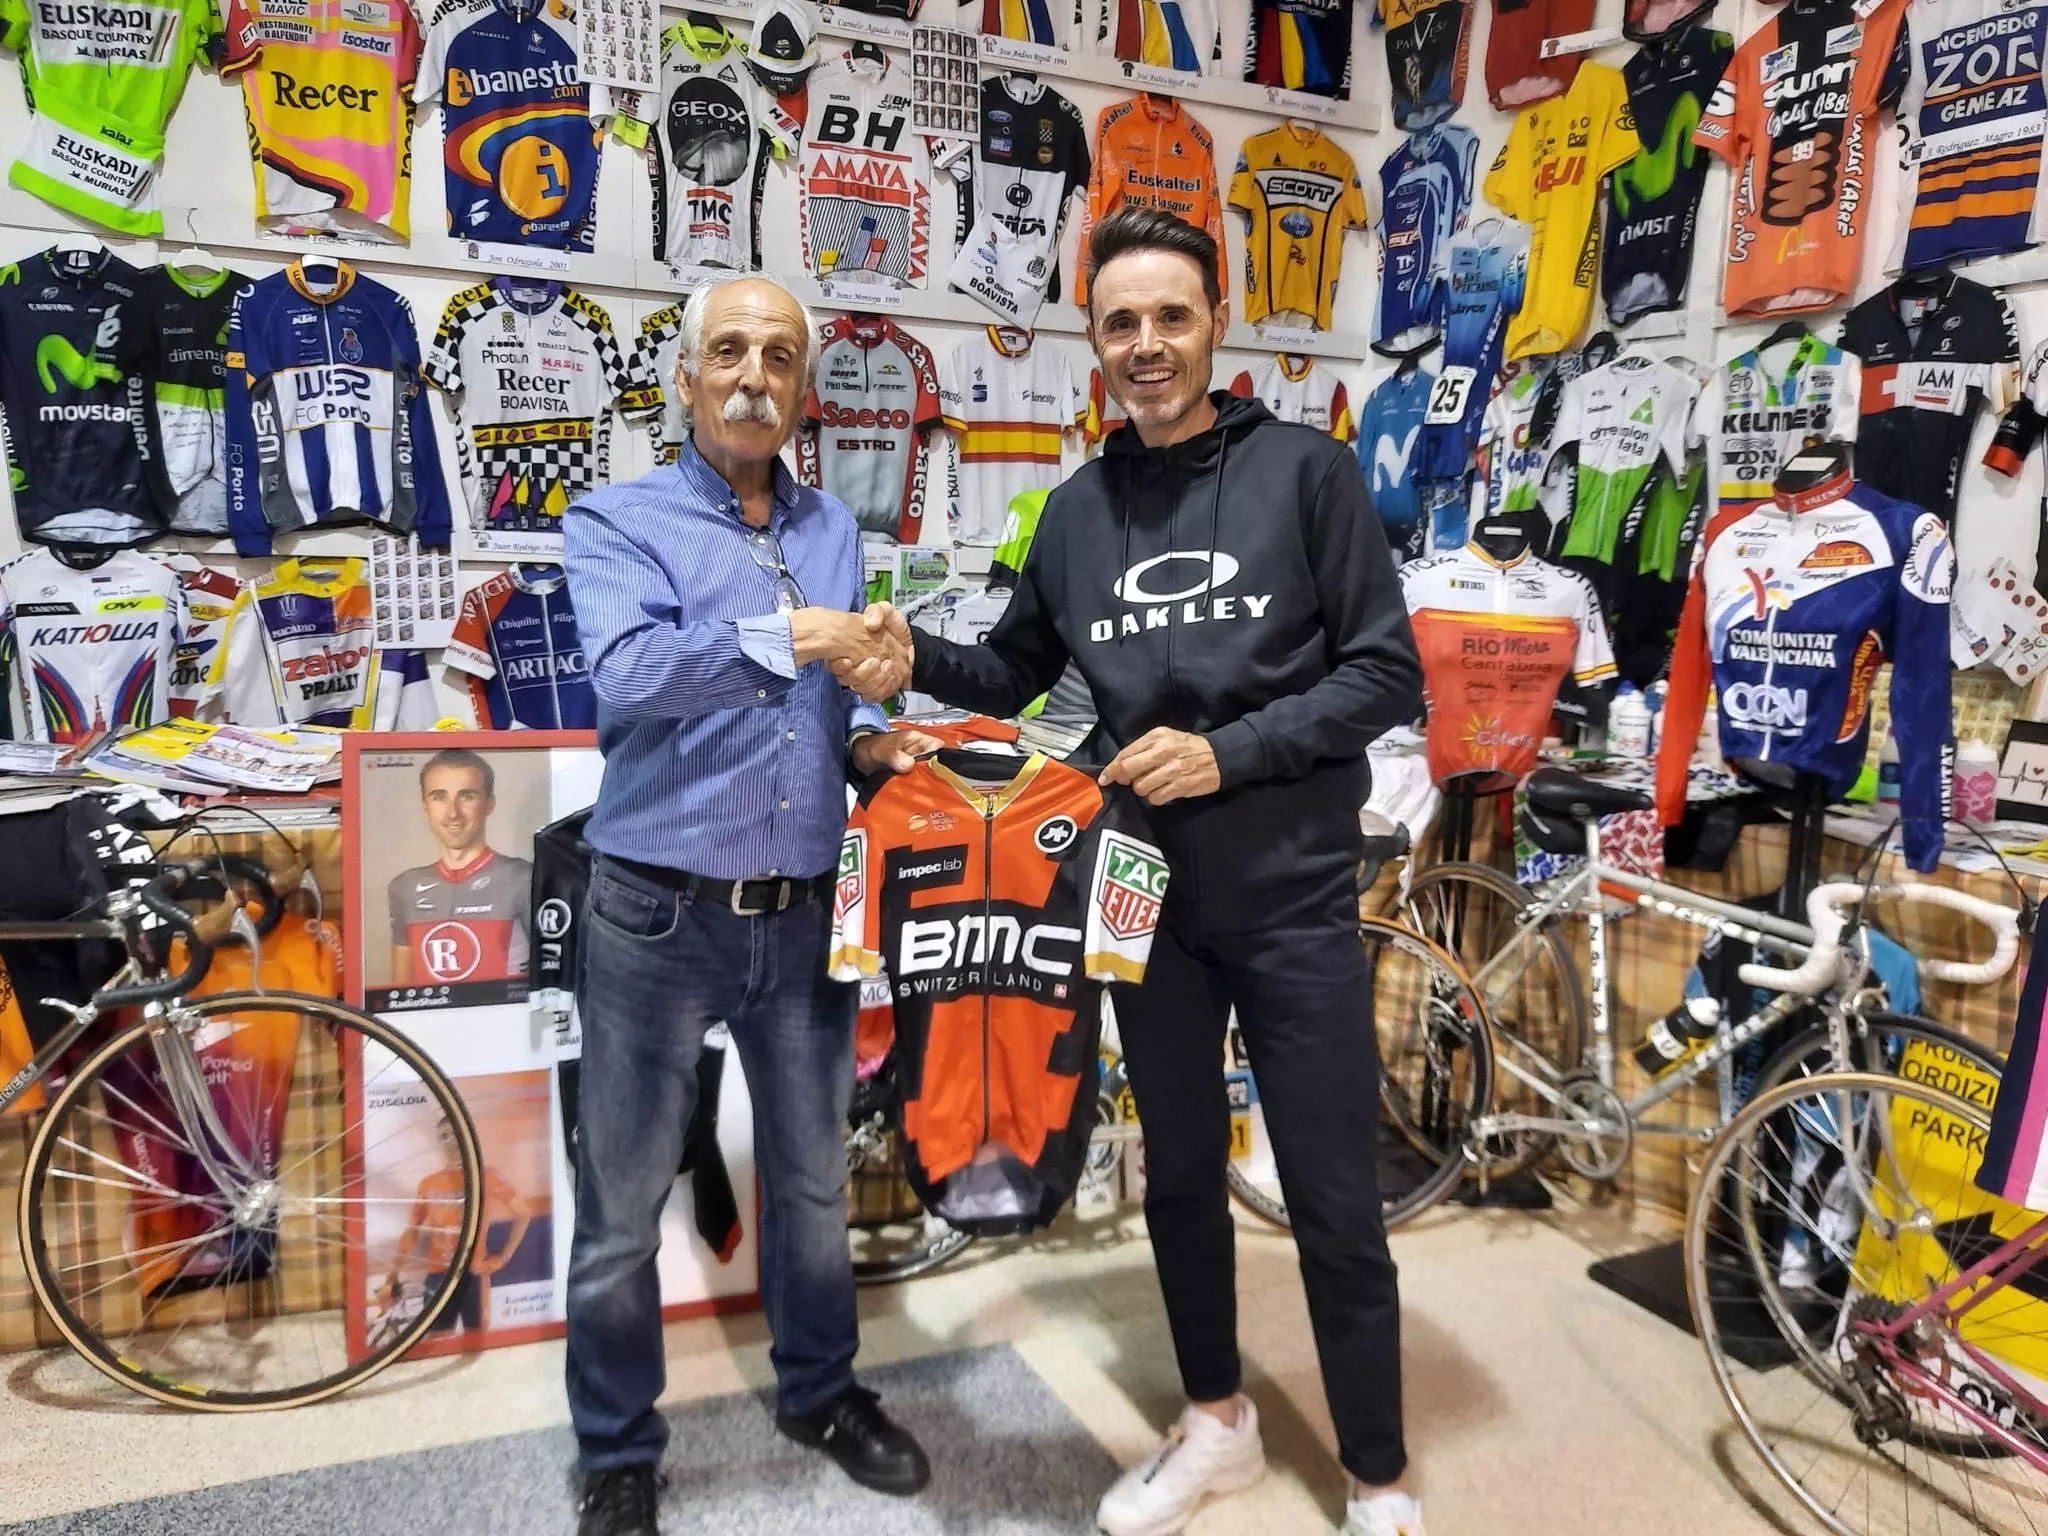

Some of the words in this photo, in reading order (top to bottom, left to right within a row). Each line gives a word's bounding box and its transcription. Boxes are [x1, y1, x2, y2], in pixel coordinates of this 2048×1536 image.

[39, 3, 153, 30] EUSKADI
[264, 3, 306, 16] MAVIC
[42, 29, 93, 42] BASQUE
[95, 31, 154, 45] COUNTRY
[258, 20, 313, 35] RESTAURANTE
[94, 47, 147, 60] MURIAS
[342, 31, 392, 54] isostar
[271, 71, 378, 112] Recer
[551, 85, 584, 99] .com
[671, 100, 748, 125] GEOX
[818, 104, 905, 151] BH
[2017, 124, 2041, 137] 1983
[57, 135, 138, 178] EUSKADI
[1792, 141, 1815, 161] 99
[51, 148, 90, 172] BASQUE
[90, 168, 135, 187] COUNTRY
[812, 154, 908, 190] AMAYA
[84, 175, 126, 197] MURIAS
[1128, 169, 1201, 193] Euskaltel
[1268, 179, 1335, 201] SCOTT
[688, 199, 733, 225] TMC
[969, 276, 1018, 315] BOAVISTA
[642, 306, 680, 334] ecer
[1451, 303, 1487, 315] Jayco
[169, 348, 226, 363] dimensi
[497, 368, 571, 395] Recer
[1918, 368, 1954, 389] IAM
[501, 396, 570, 413] BOAVISTA
[1432, 379, 1464, 414] 25
[296, 406, 320, 424] FC
[823, 401, 910, 429] Saeco
[837, 439, 896, 451] ESTRO
[1090, 594, 1273, 642] OAKLEY
[29, 622, 160, 648] КАТЮША
[1730, 628, 1837, 650] COMUNITAT
[507, 652, 588, 683] ARTIAC
[1730, 644, 1836, 668] VALENCIANA
[899, 862, 942, 880] impec
[942, 858, 963, 873] lab
[899, 913, 1082, 977] BMC
[389, 996, 449, 1009] RadioShack
[1903, 1058, 1996, 1106] ORDIZI
[1910, 1110, 1984, 1154] PARK
